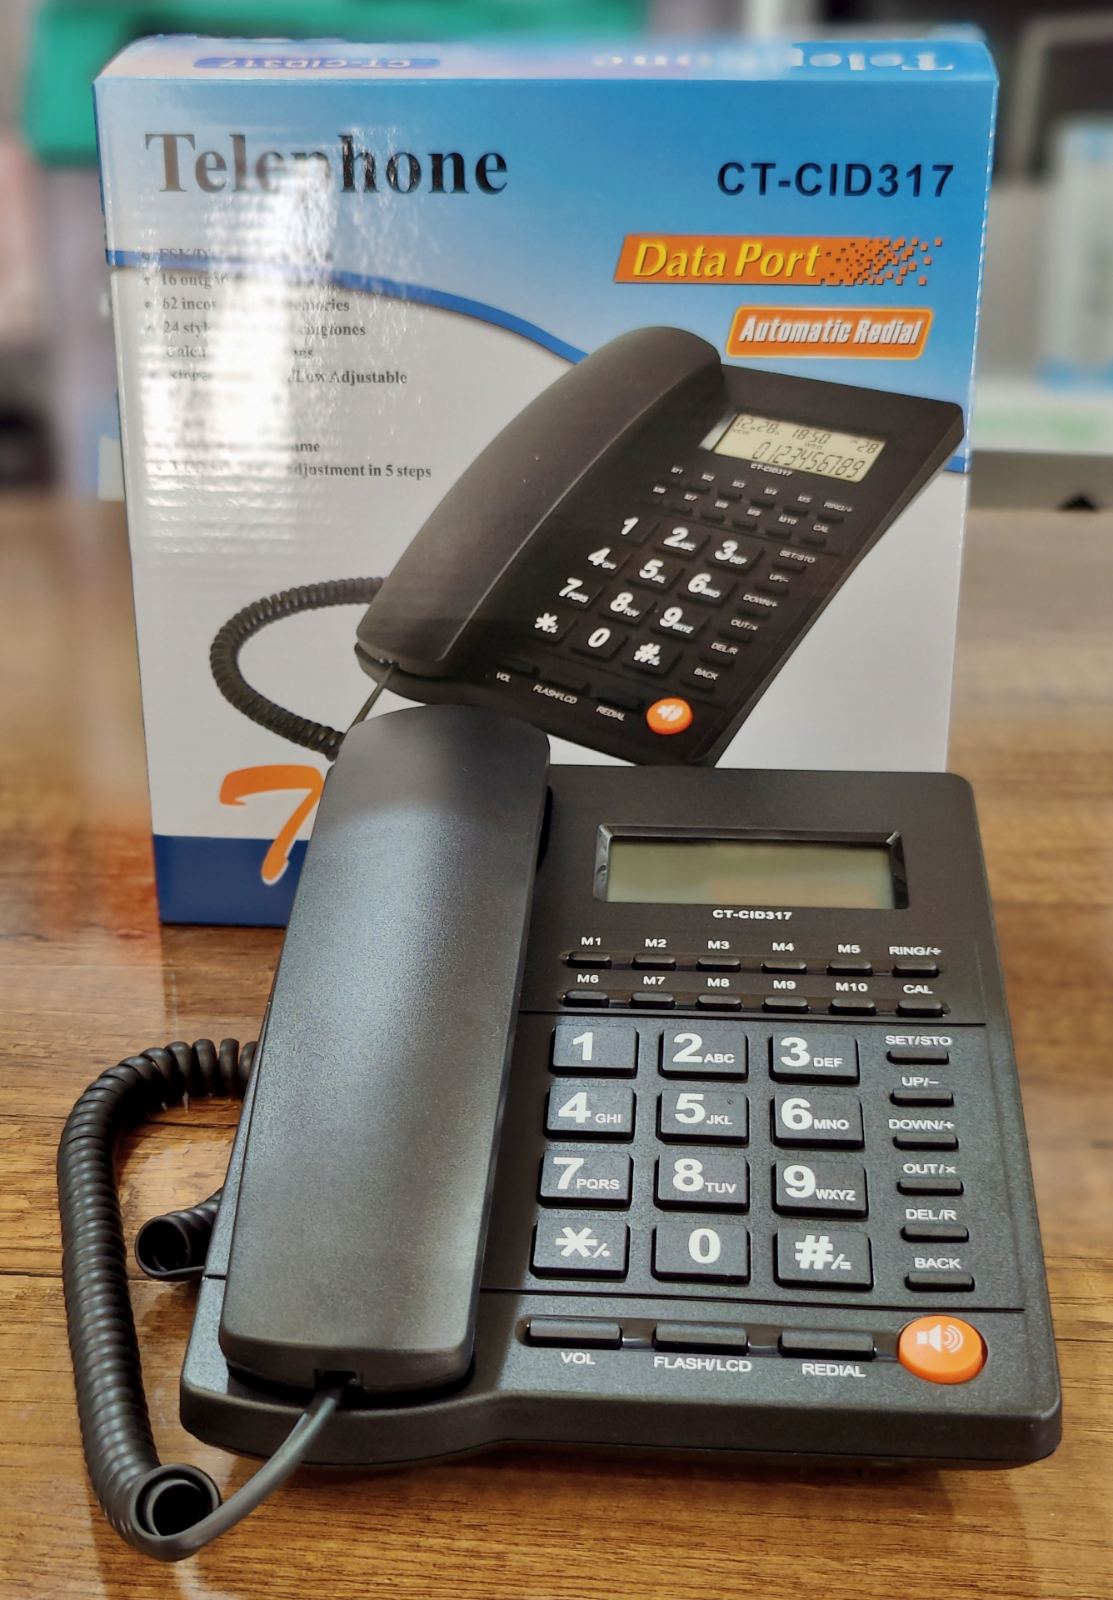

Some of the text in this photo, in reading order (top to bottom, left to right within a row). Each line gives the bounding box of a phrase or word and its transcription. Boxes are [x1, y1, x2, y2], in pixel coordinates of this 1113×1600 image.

[717, 162, 954, 198] CT-CID317
[632, 243, 823, 278] Data Port
[739, 316, 922, 345] Automatic Redial
[329, 370, 407, 386] Adjustable
[752, 441, 866, 478] 0123456789
[368, 464, 381, 477] in
[385, 464, 394, 477] 5
[396, 466, 432, 481] steps
[621, 517, 639, 535] 1
[663, 527, 689, 547] 2
[588, 547, 611, 566] 4
[715, 540, 738, 560] 3
[639, 559, 664, 579] 5
[559, 577, 583, 597] 7
[688, 573, 712, 594] 6
[610, 592, 634, 613] 8
[660, 607, 683, 627] 9
[588, 628, 611, 648] 0
[694, 668, 719, 680] BACK
[712, 909, 793, 921] CT-CID317
[580, 937, 602, 946] M1
[645, 938, 667, 948] M2
[707, 940, 730, 950] M3
[772, 942, 795, 952] M4
[837, 944, 861, 954] M5
[576, 974, 599, 984] M6
[643, 976, 666, 986] M7
[707, 978, 730, 988] M8
[773, 980, 796, 990] M9
[836, 982, 868, 993] M10
[903, 984, 934, 995] CAL
[572, 1032, 594, 1061] 1
[672, 1033, 735, 1064] 2 ABC
[885, 1035, 952, 1047] SET/STO
[780, 1037, 843, 1068] 3 DEF
[558, 1092, 622, 1124] 4 GHI
[675, 1093, 733, 1126] 5 JKL
[781, 1098, 850, 1130] 6 MNO
[888, 1119, 954, 1131] DOWN/+
[552, 1158, 620, 1191] 7 PQRS
[672, 1159, 737, 1194] 8 TUV
[782, 1165, 856, 1201] 9 WXYZ
[905, 1209, 957, 1222] DEL/R
[688, 1228, 721, 1264] 0
[914, 1257, 961, 1270] BACK
[561, 1351, 595, 1365] VOL
[653, 1356, 752, 1373] FLASH/LCD
[802, 1363, 866, 1378] REDIAL
